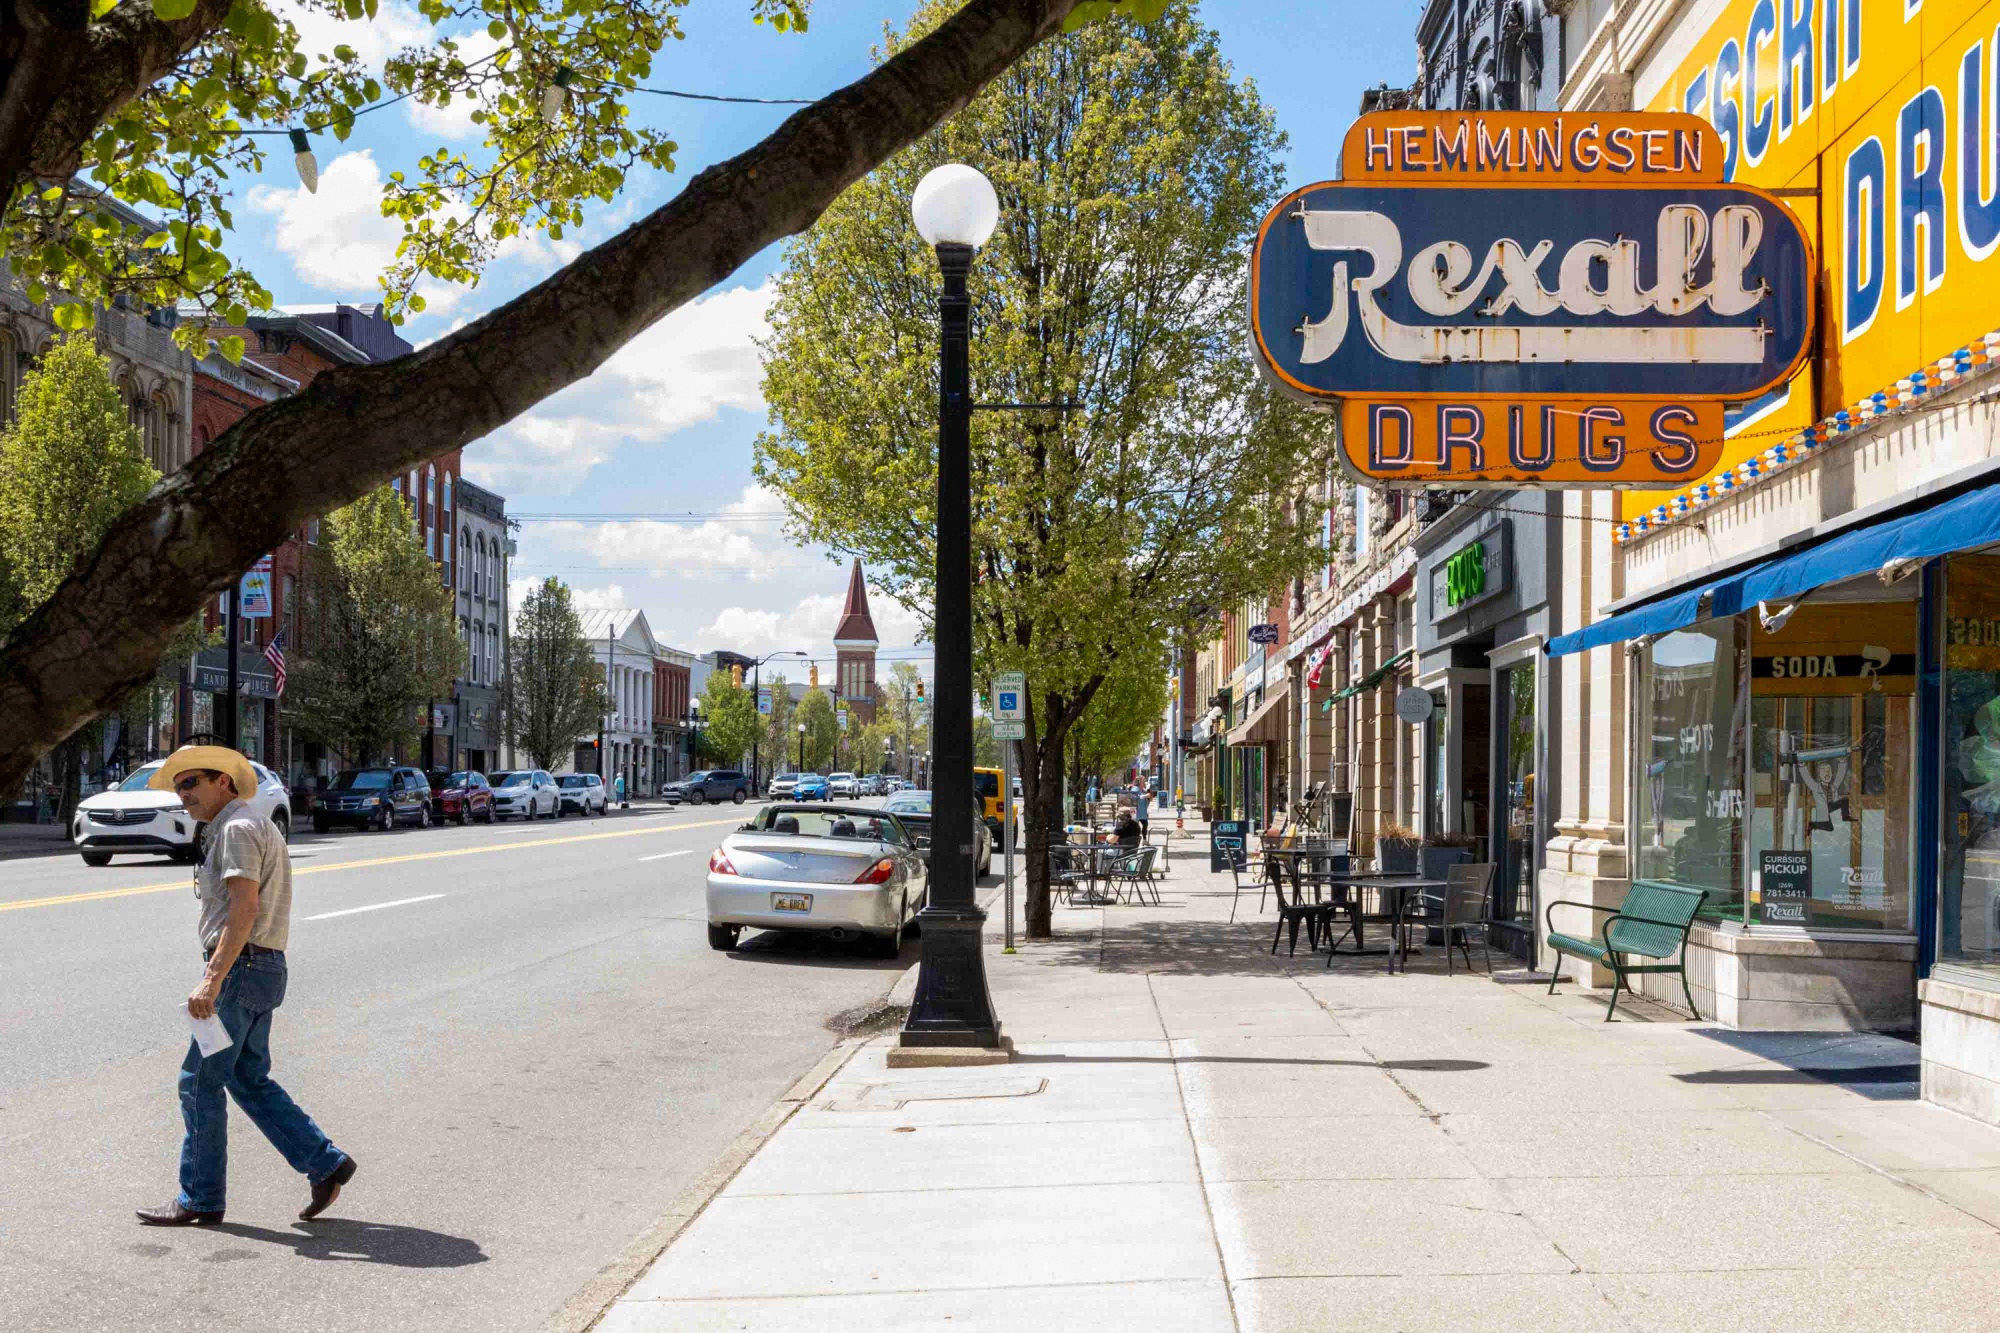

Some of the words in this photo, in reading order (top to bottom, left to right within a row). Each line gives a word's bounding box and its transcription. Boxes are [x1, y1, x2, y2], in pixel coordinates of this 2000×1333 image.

[1364, 119, 1703, 172] HEMMINGSEN
[1299, 204, 1768, 364] Rexall
[1367, 404, 1700, 473] DRUGS
[1772, 656, 1837, 678] SODA
[1651, 671, 1684, 701] SHOTS
[1680, 723, 1714, 754] SHOTS
[1706, 789, 1743, 819] SHOTS
[1764, 864, 1807, 874] PICKUP
[1765, 856, 1807, 864] CURBSIDE
[1766, 890, 1806, 898] 781-3411
[1765, 903, 1806, 920] Rexall
